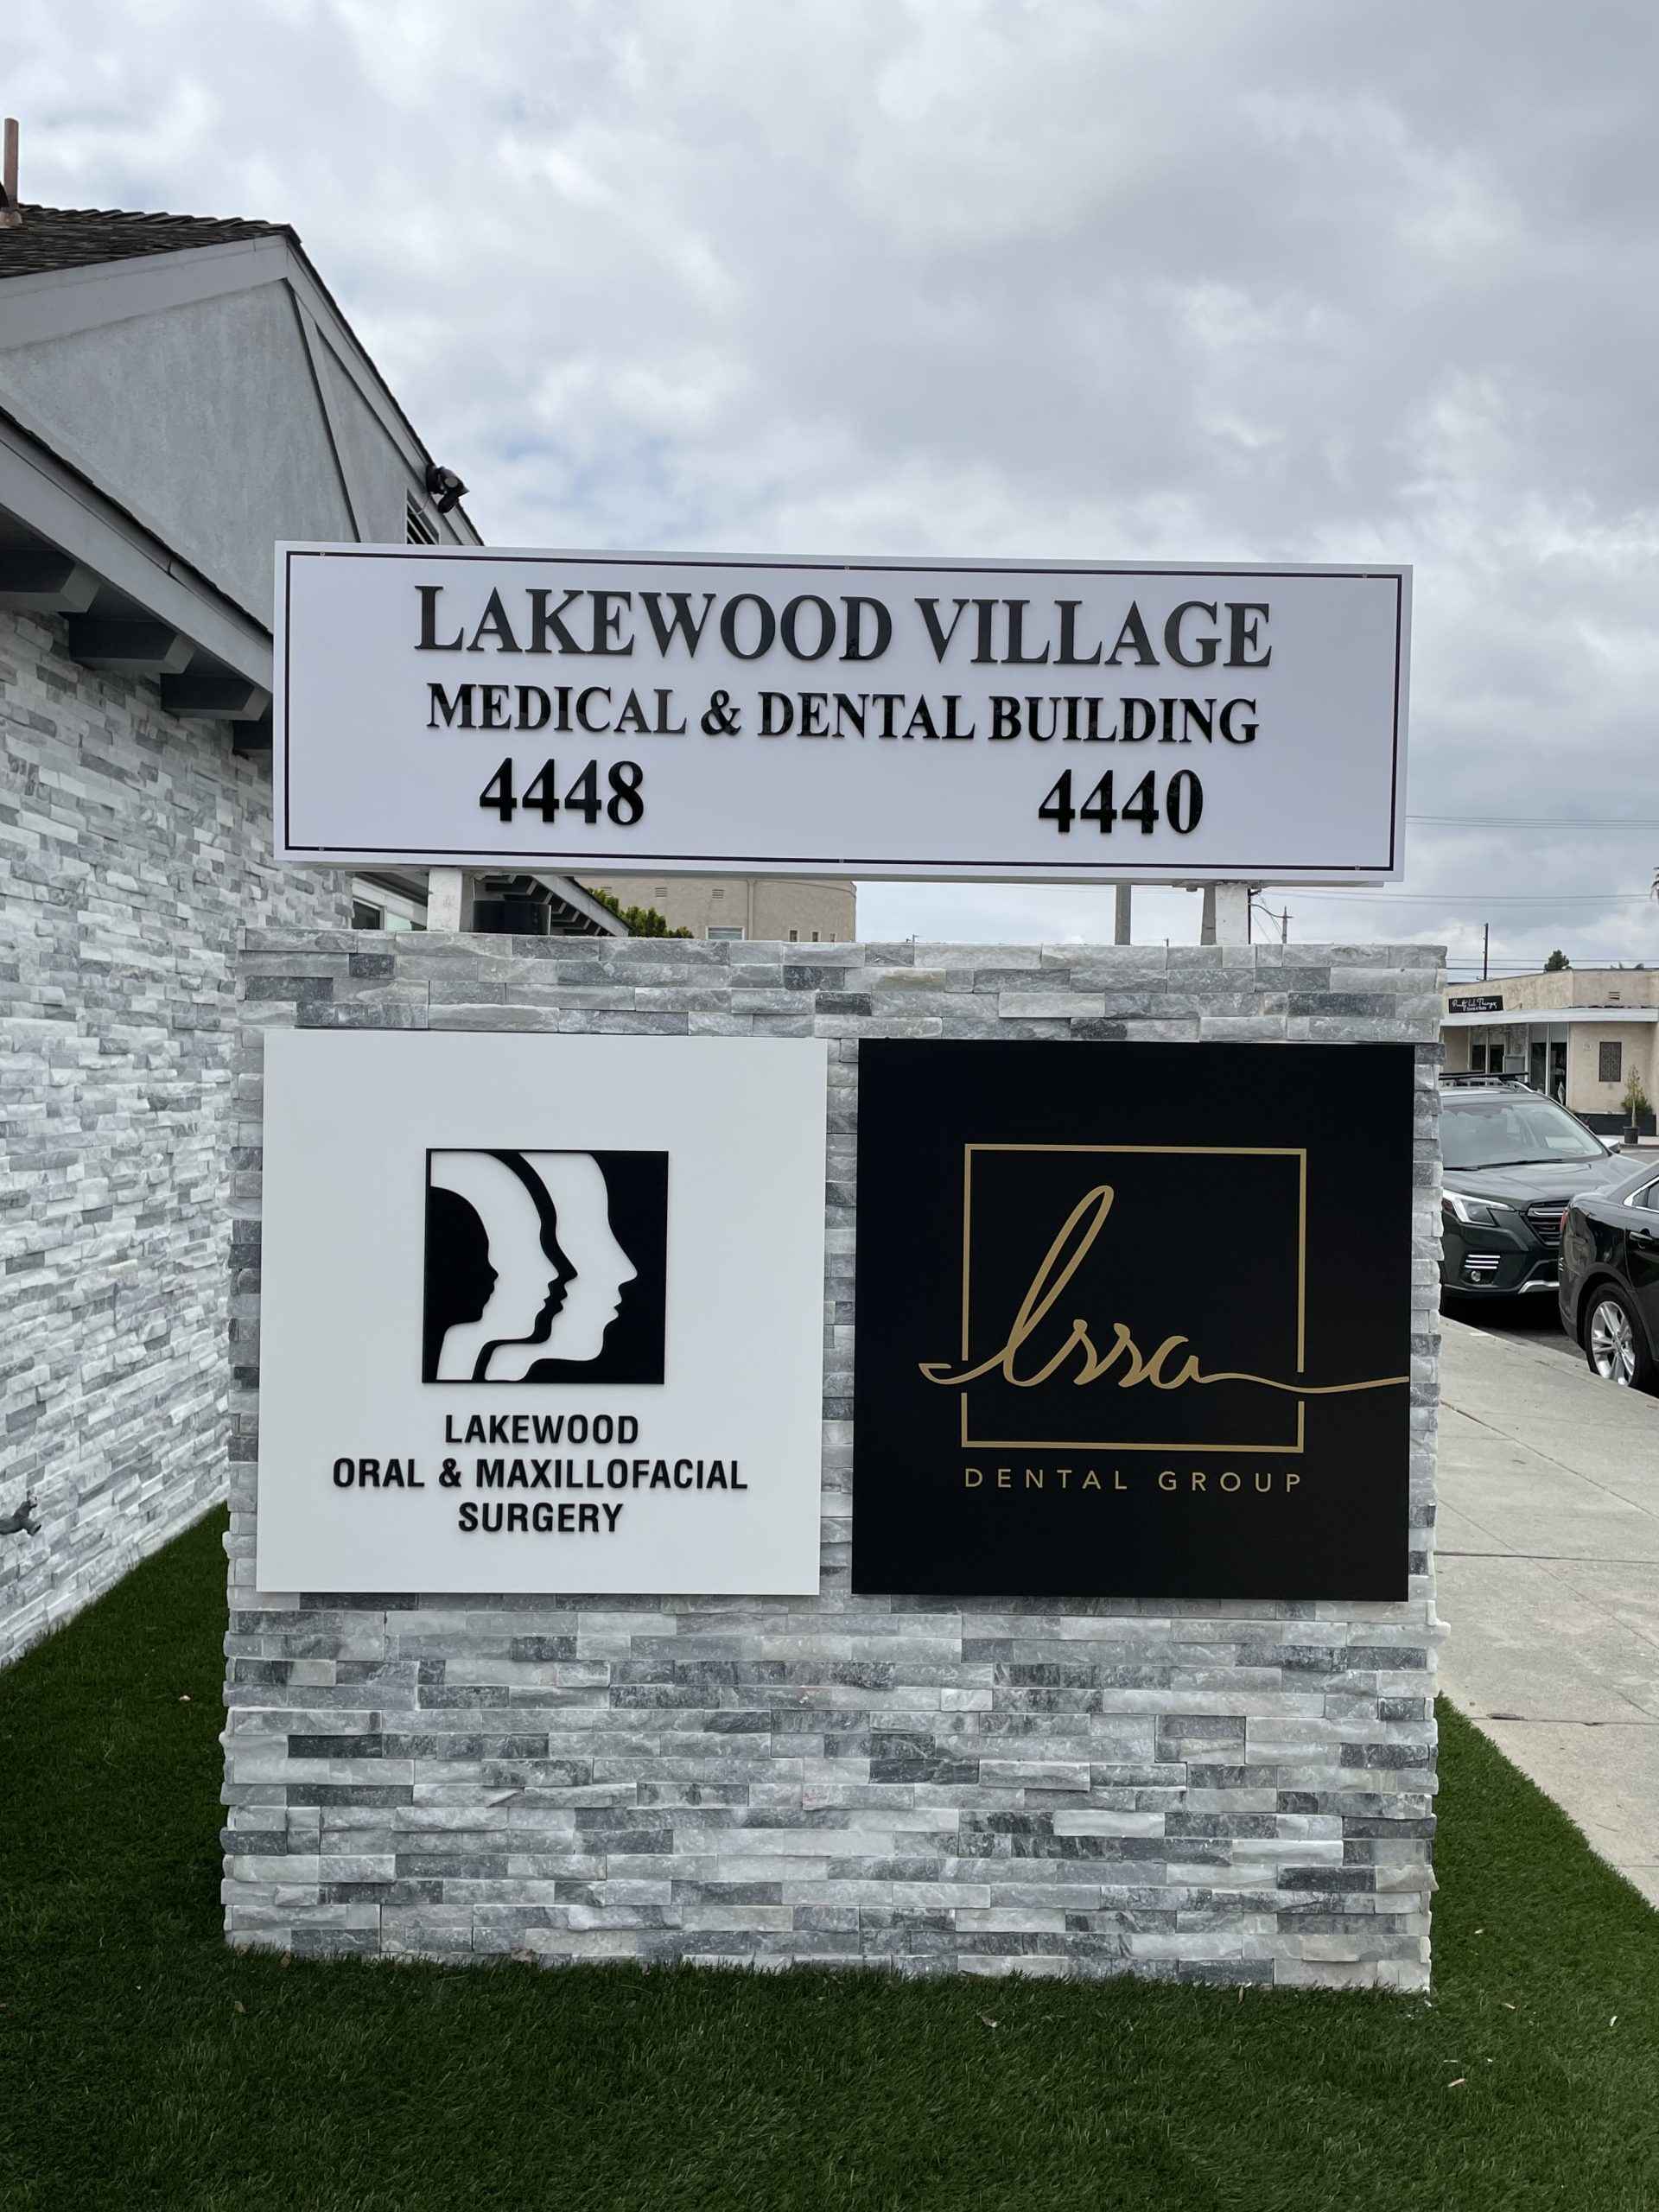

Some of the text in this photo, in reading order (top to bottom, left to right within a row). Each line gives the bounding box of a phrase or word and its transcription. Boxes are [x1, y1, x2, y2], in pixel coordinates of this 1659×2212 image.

[415, 585, 1273, 668] LAKEWOOD VILLAGE
[426, 683, 1260, 745] MEDICAL & DENTAL BUILDING
[480, 757, 645, 826] 4448
[1038, 768, 1204, 835] 4440
[445, 1414, 639, 1445] LAKEWOOD
[333, 1457, 748, 1490] ORAL & MAXILLOFACIAL
[965, 1467, 1301, 1493] DENTAL GROUP
[458, 1502, 624, 1533] SURGERY
